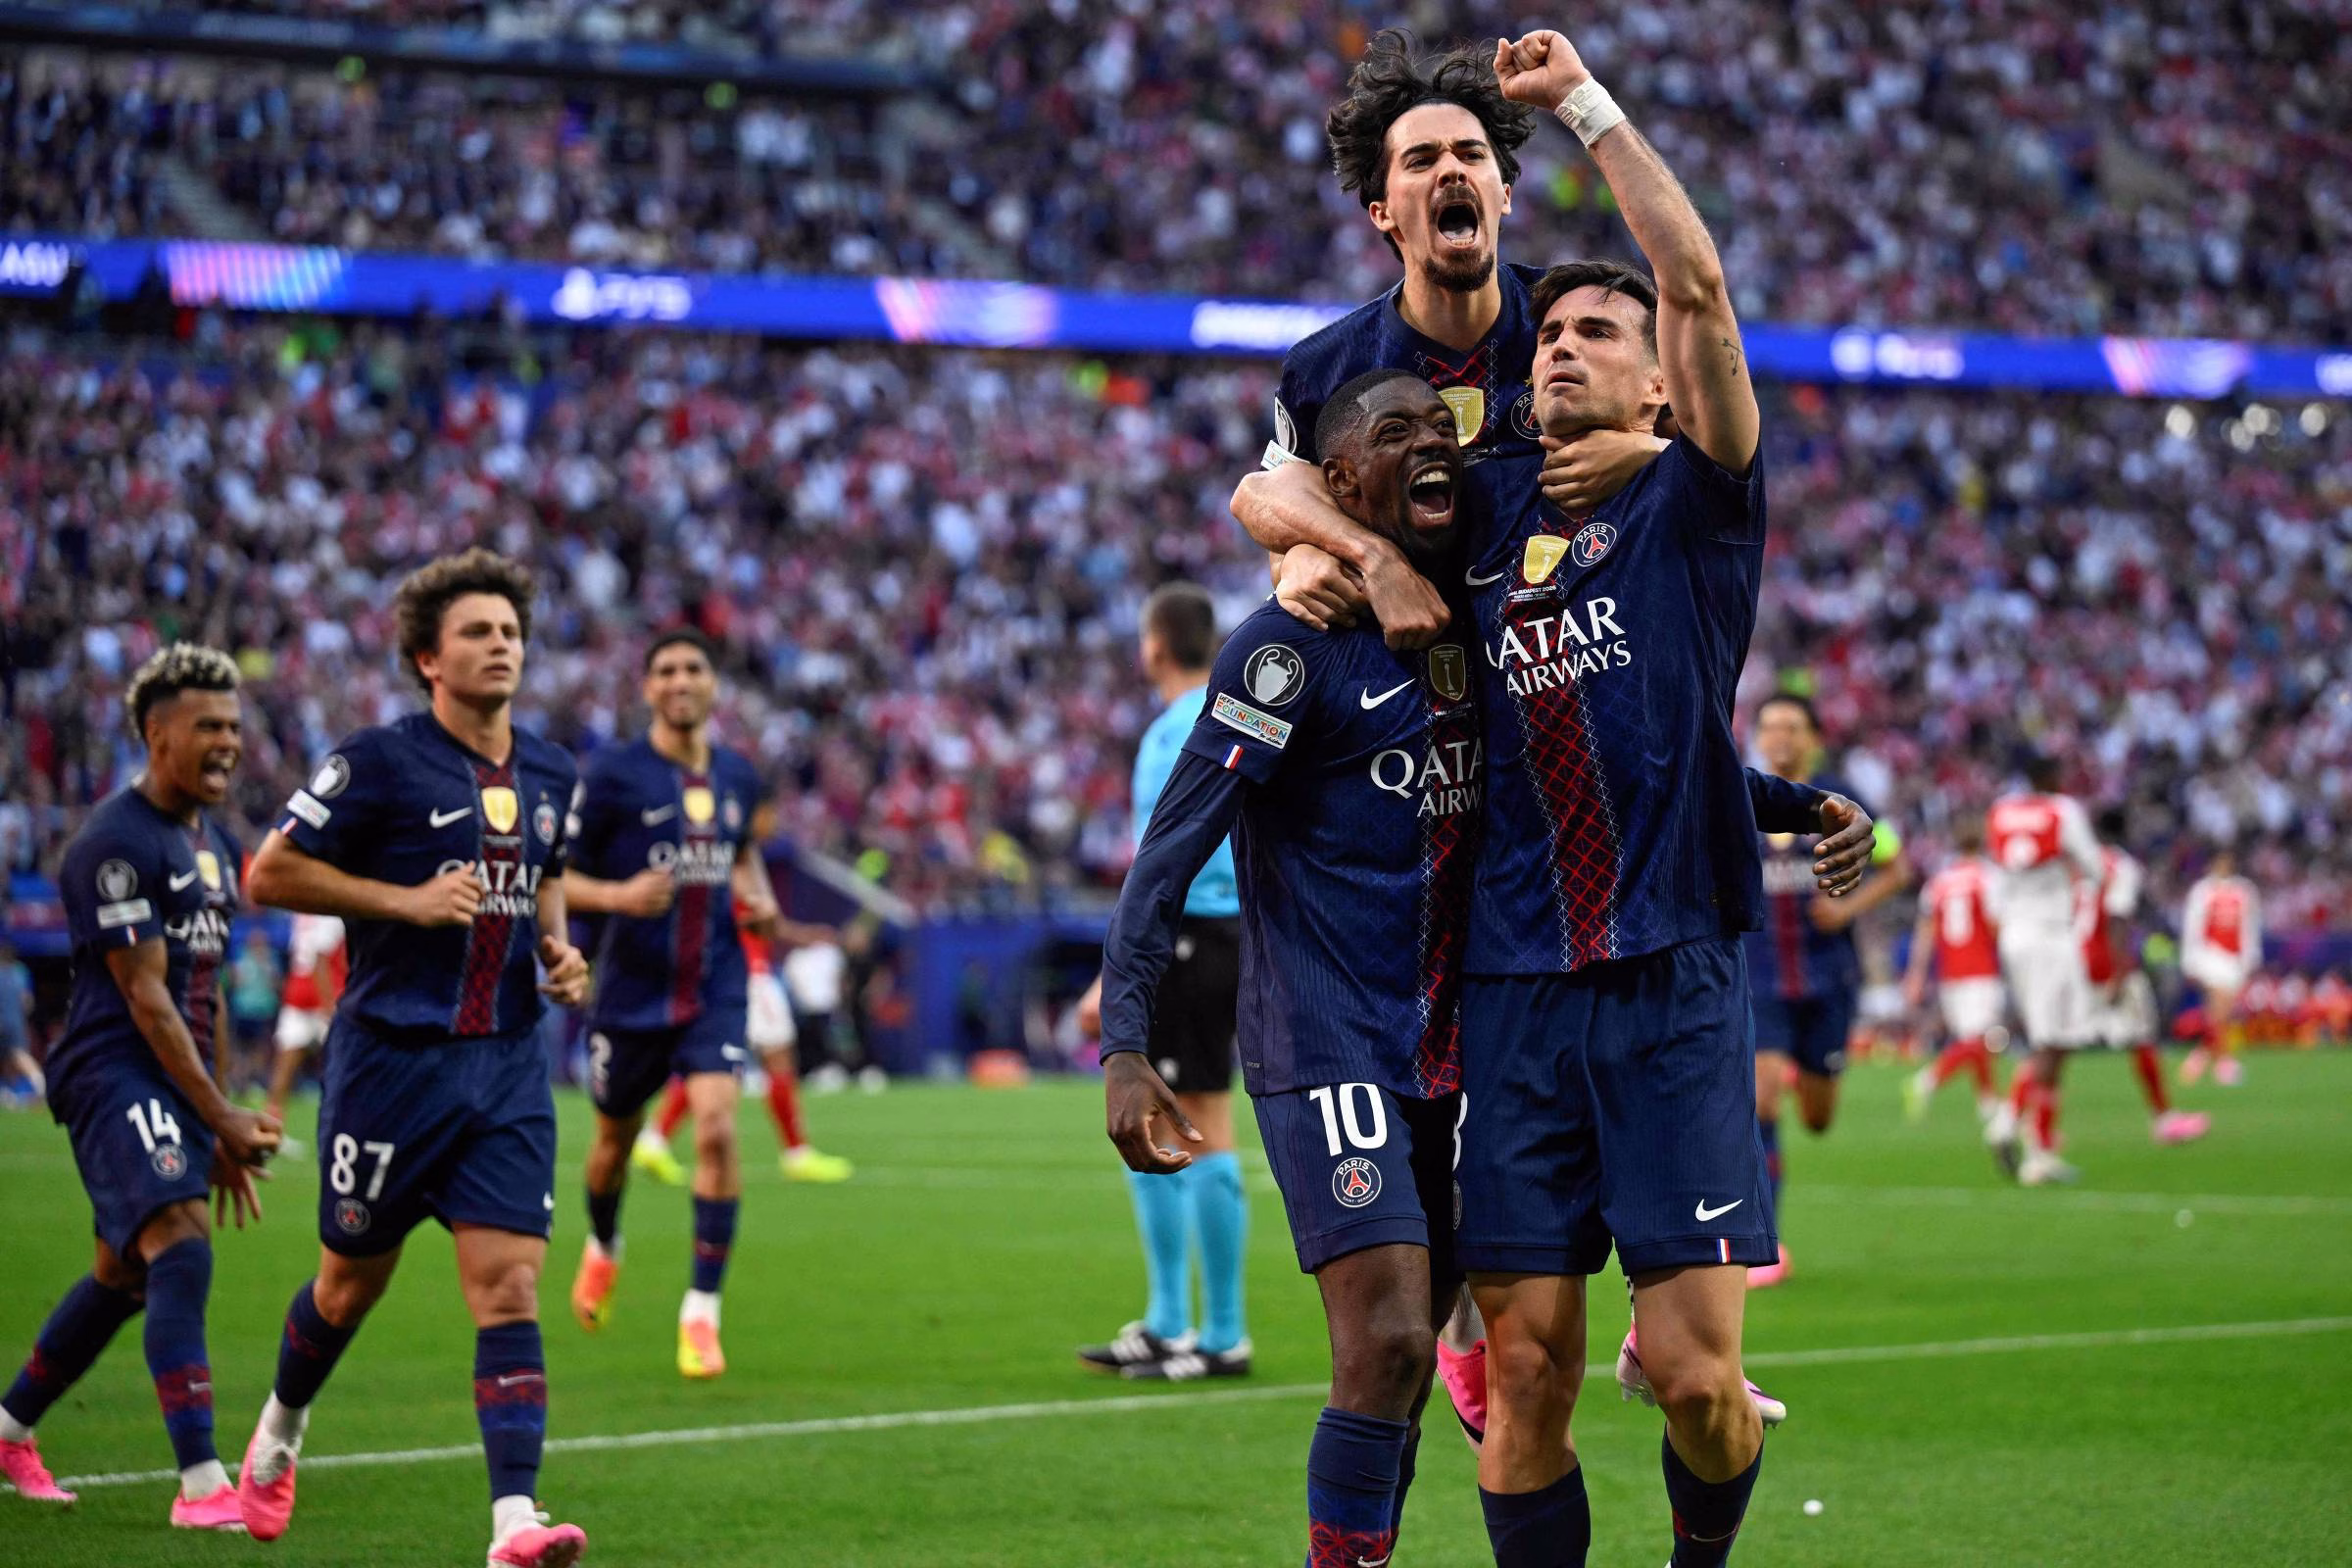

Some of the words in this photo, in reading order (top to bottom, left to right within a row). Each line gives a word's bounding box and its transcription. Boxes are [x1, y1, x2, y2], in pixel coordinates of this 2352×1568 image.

[1577, 524, 1608, 543] PARIS
[1507, 640, 1632, 698] AIRWAYS
[1216, 700, 1287, 740] FOUNDATION
[1219, 695, 1235, 705] UEFA
[1370, 737, 1483, 800] QATA
[1416, 784, 1483, 817] AIRW
[126, 1098, 181, 1154] 14
[1308, 1082, 1388, 1156] 10
[330, 1133, 395, 1201] 87
[1338, 1159, 1370, 1176] PARIS
